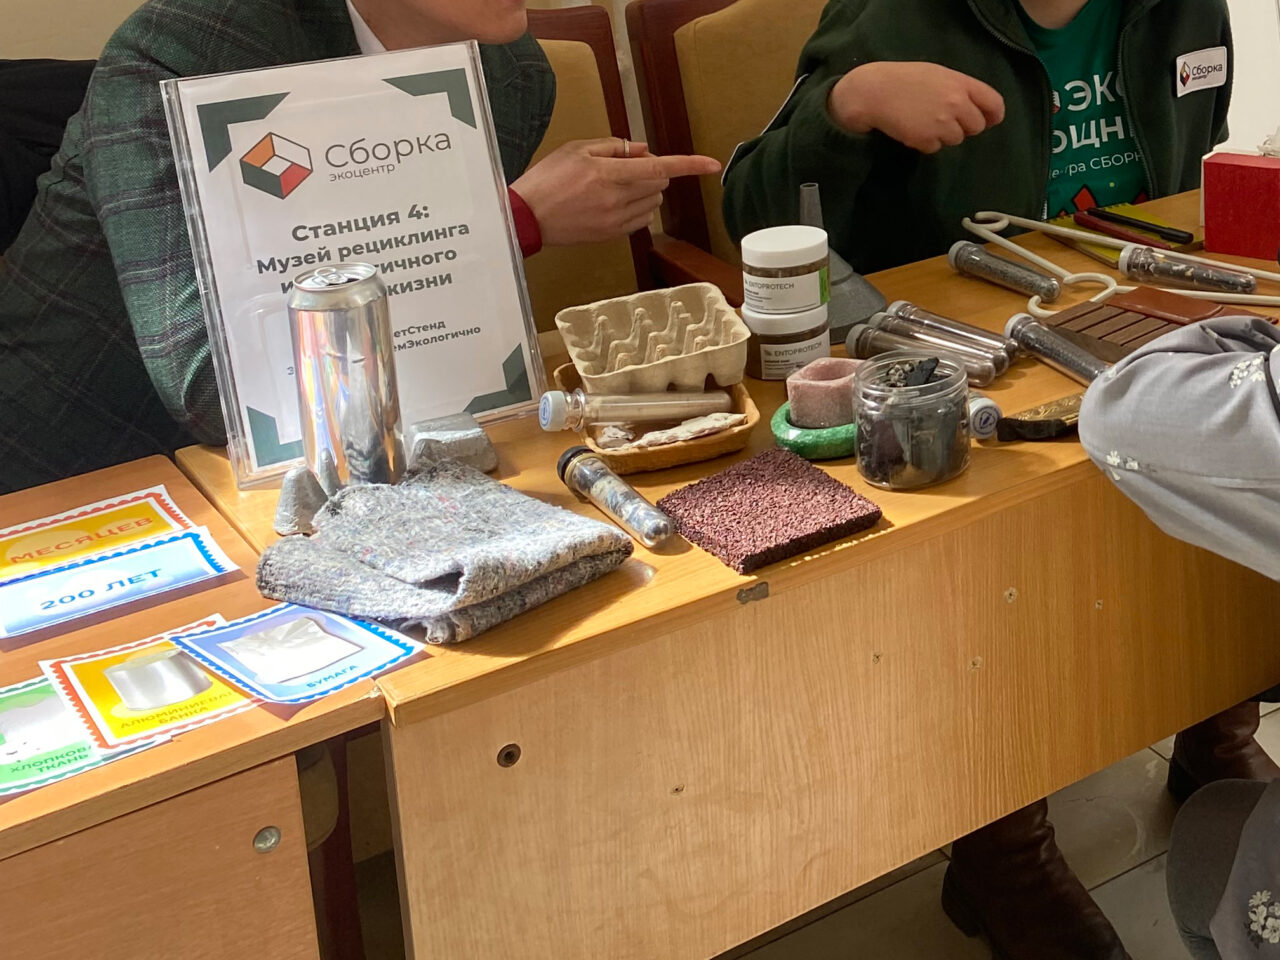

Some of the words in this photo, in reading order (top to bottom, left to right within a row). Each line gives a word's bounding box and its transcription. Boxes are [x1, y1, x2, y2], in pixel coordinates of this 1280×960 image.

[1192, 63, 1223, 76] Сборка
[325, 132, 452, 168] Сборка
[329, 163, 395, 181] экоцентр
[291, 211, 401, 242] Станция
[407, 204, 430, 220] 4:
[256, 246, 332, 275] Музей
[337, 223, 470, 262] рециклинга
[749, 281, 795, 290] ENTOPROTECH
[393, 321, 447, 338] етСтенд
[774, 342, 822, 357] ENTOPROTECH
[10, 517, 154, 564] МЕСЯЦЕВ
[40, 589, 96, 610] 200
[105, 568, 163, 591] ЛЕТ
[306, 665, 359, 688] БУМАГА
[159, 706, 209, 724] БАНКА
[35, 754, 89, 773] ТКАНЬ
